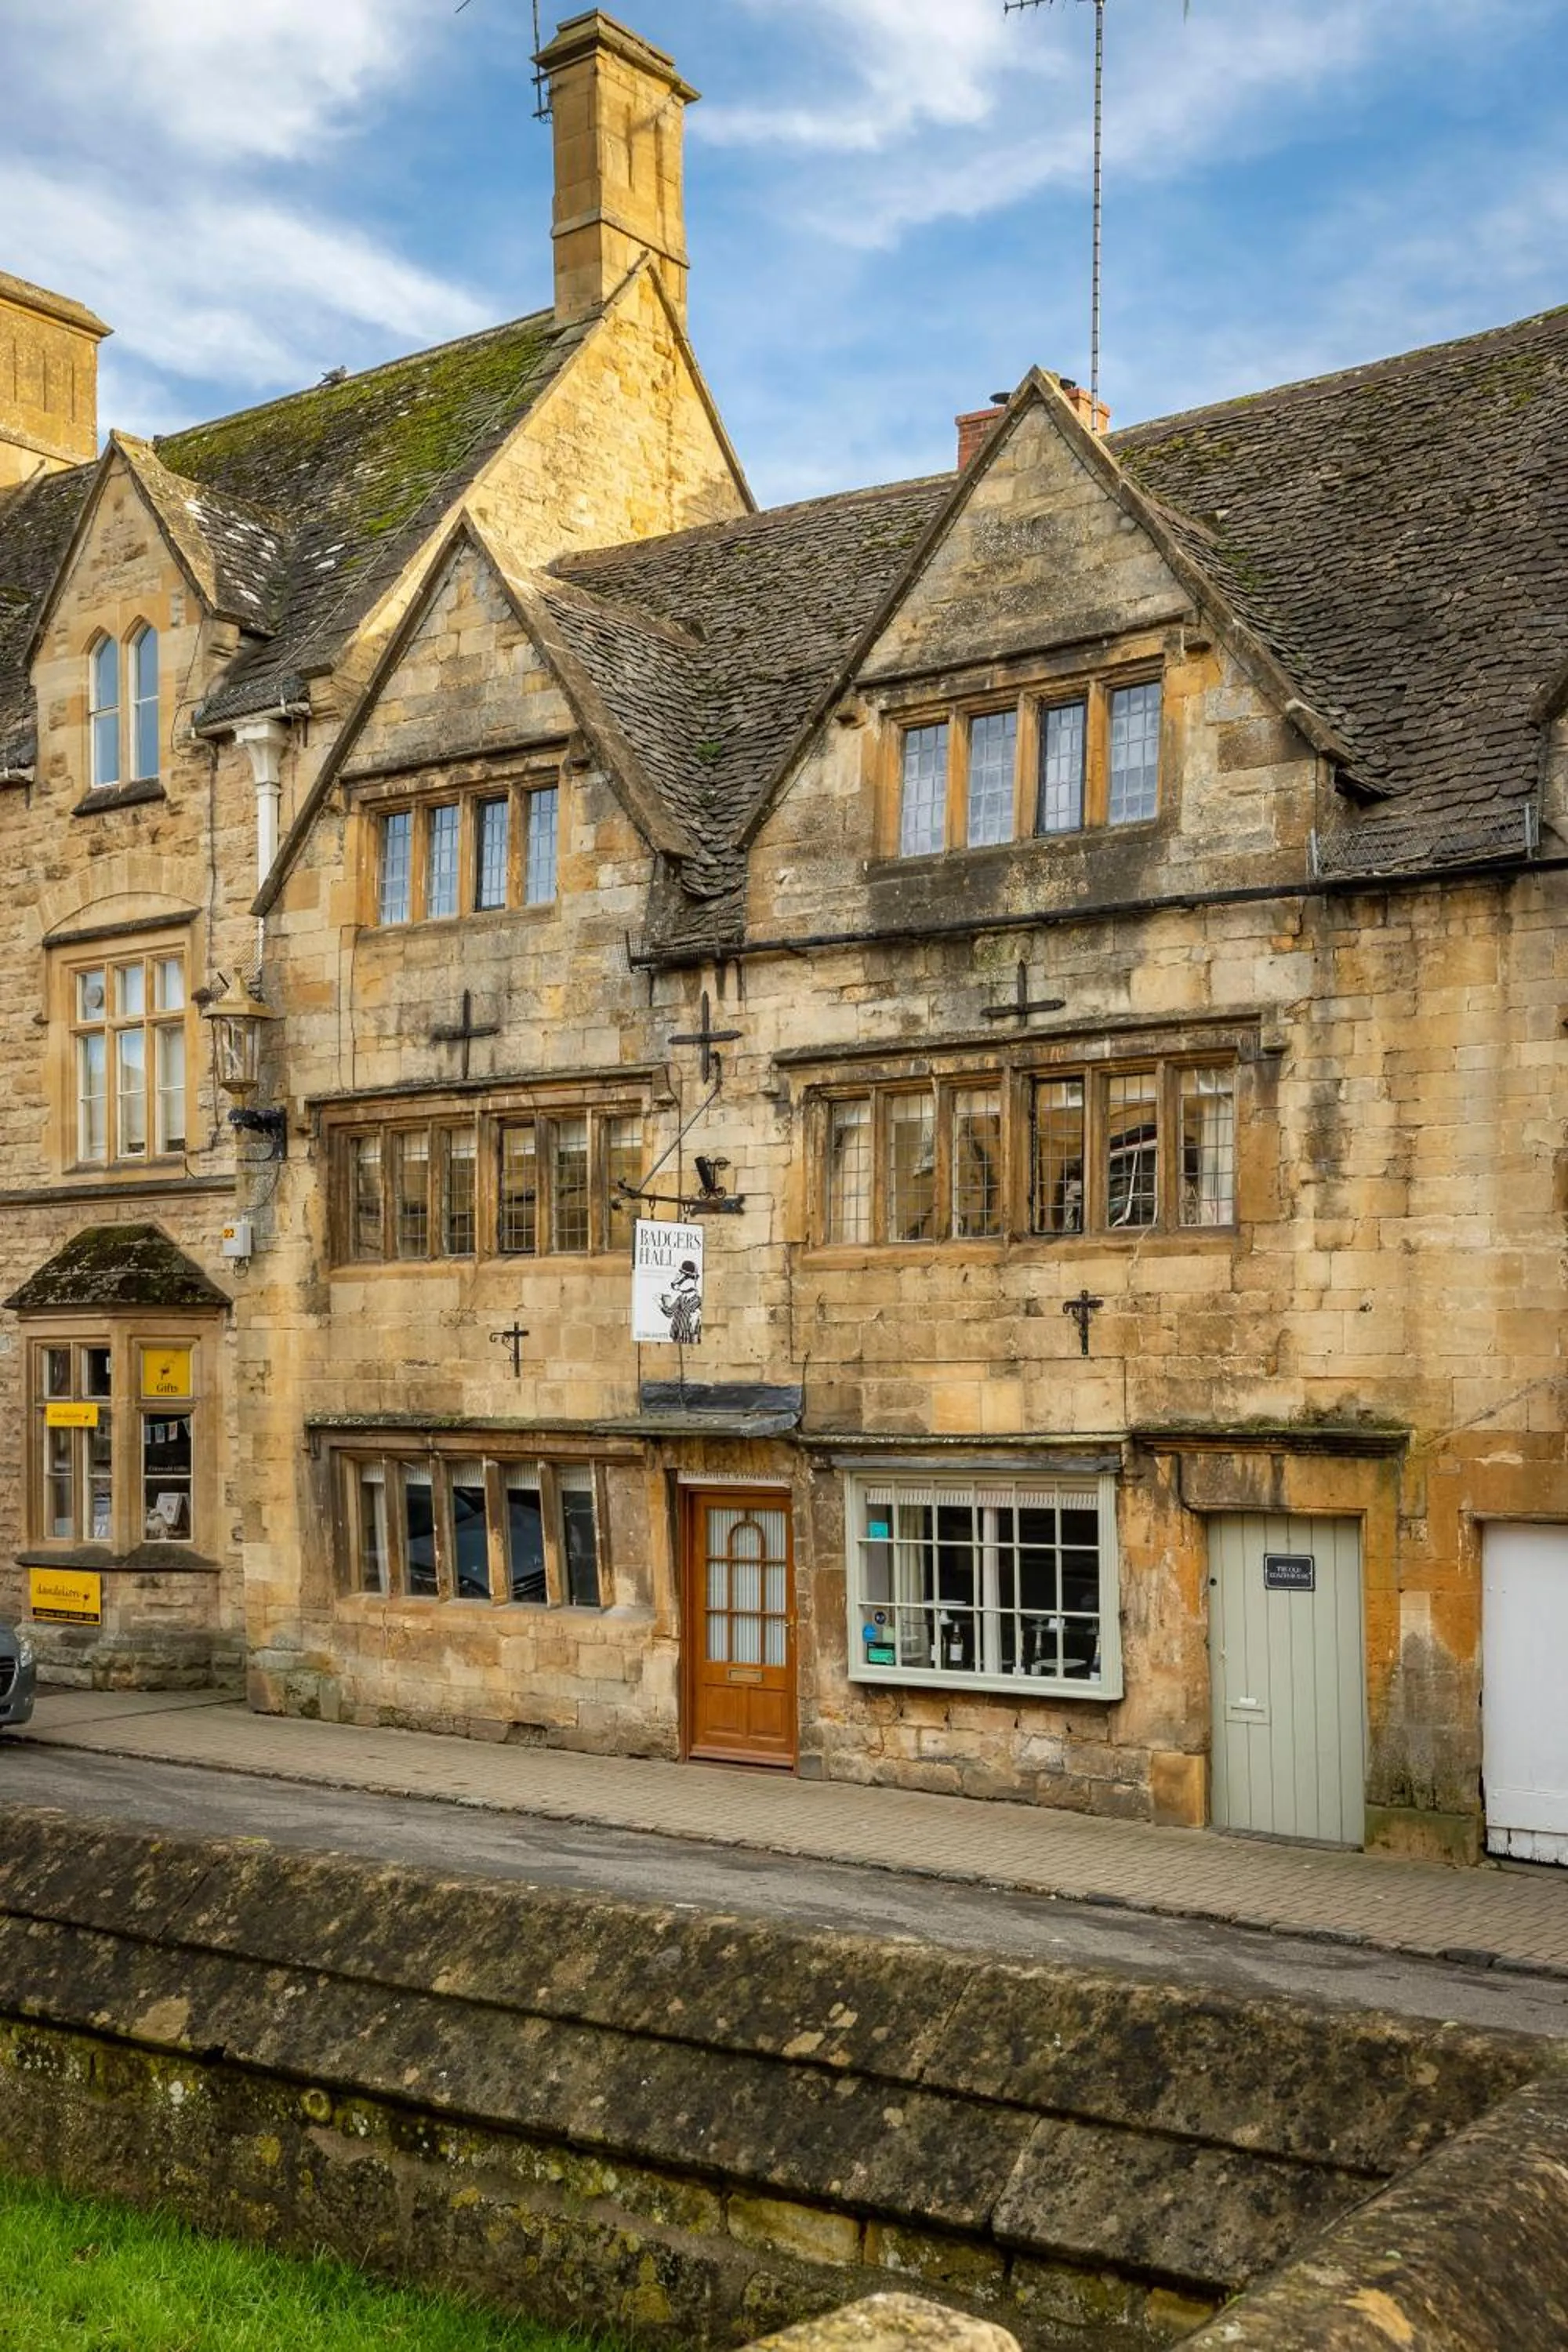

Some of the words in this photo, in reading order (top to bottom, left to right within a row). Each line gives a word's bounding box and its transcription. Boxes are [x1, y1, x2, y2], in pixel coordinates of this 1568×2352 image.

[641, 1229, 702, 1250] BADGERS
[639, 1247, 677, 1267] HALL
[156, 1382, 179, 1393] Gifts
[36, 1584, 81, 1598] dandelion
